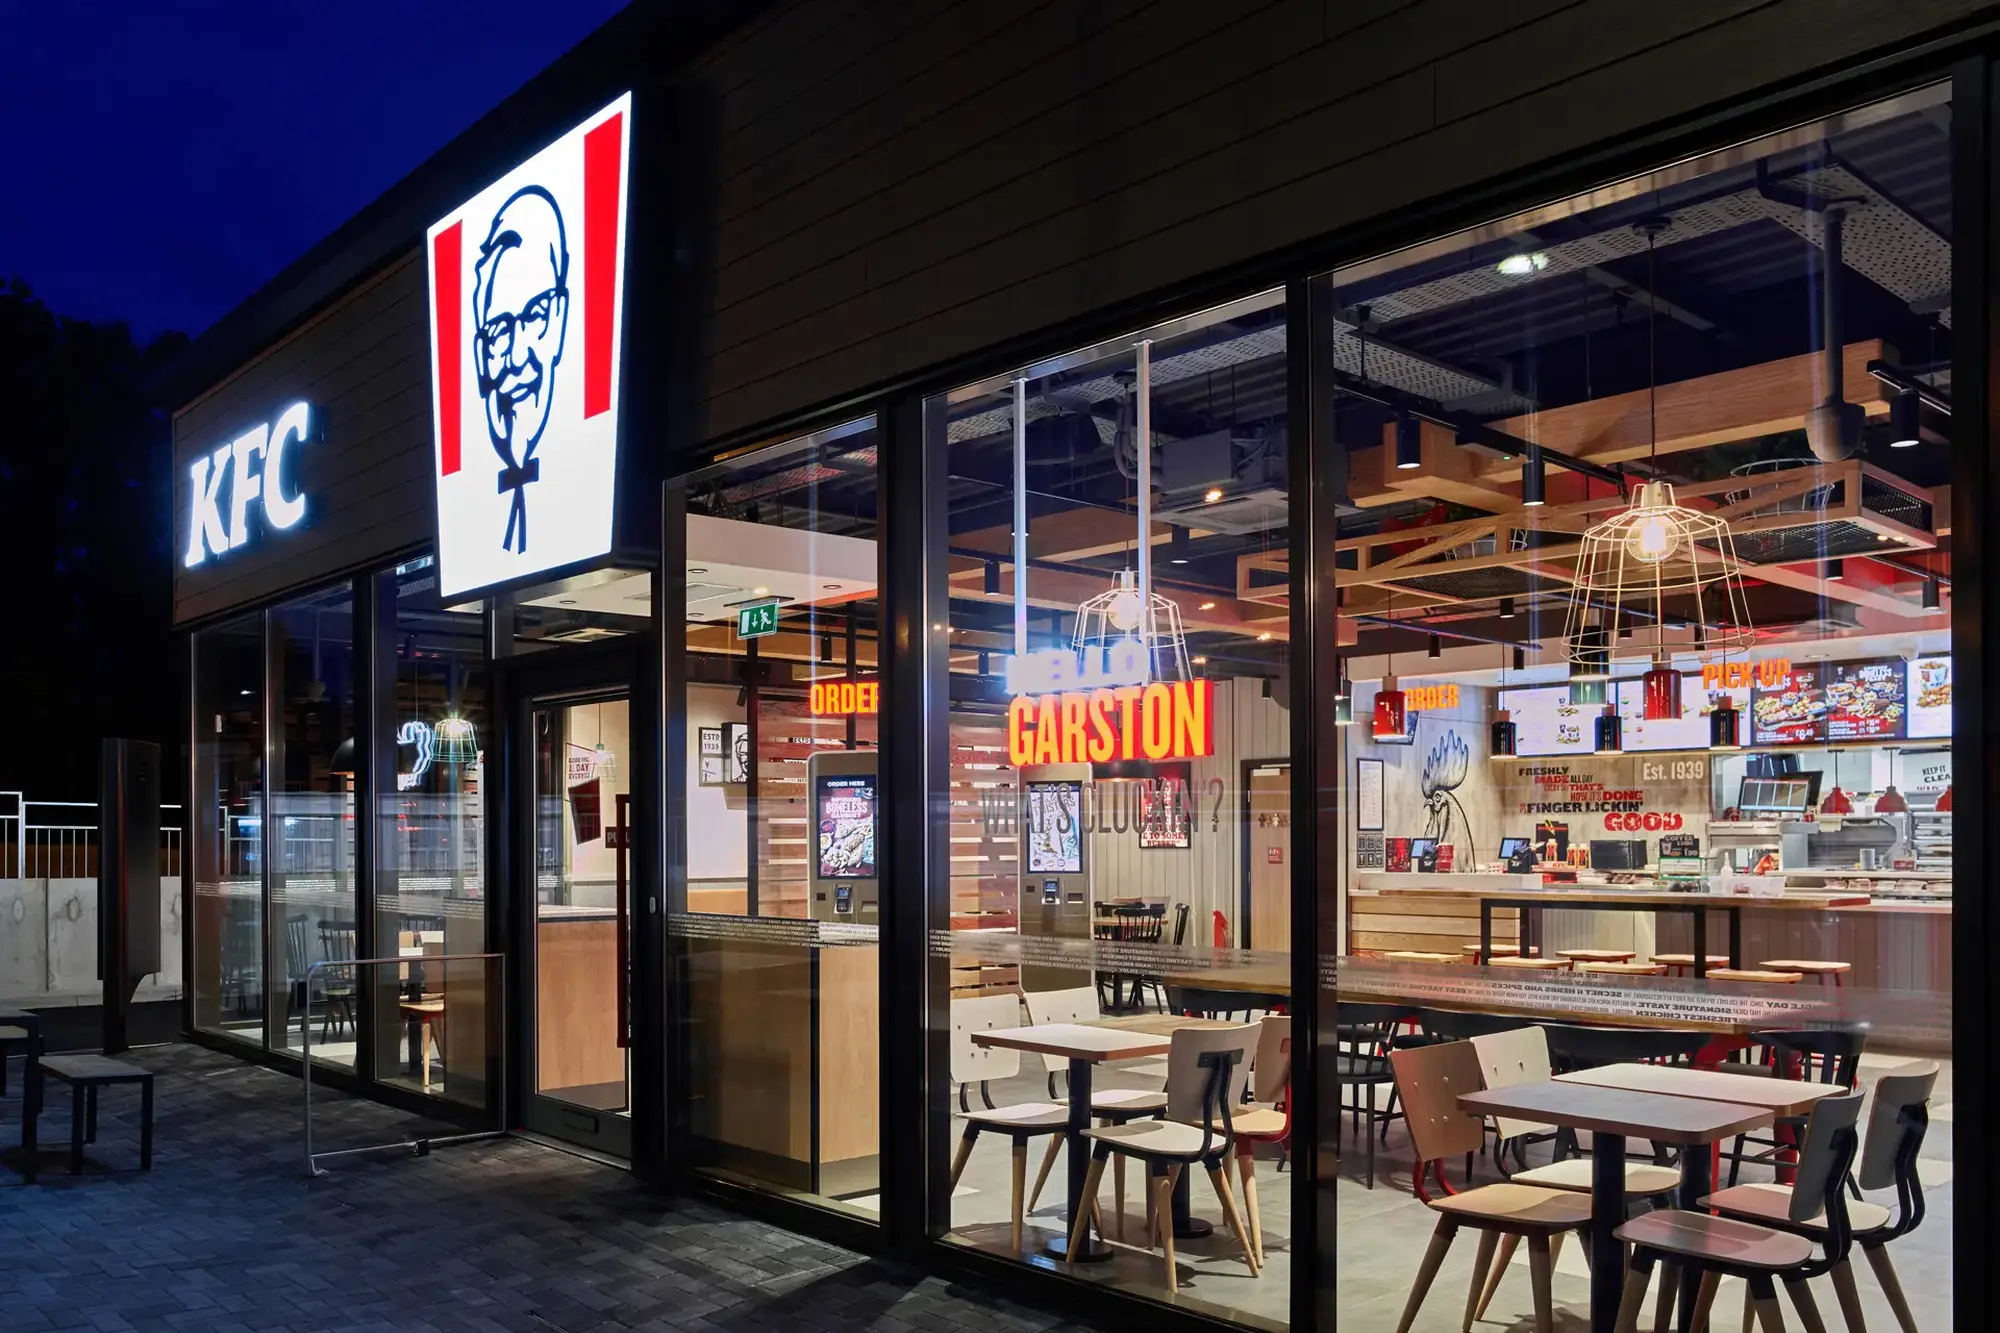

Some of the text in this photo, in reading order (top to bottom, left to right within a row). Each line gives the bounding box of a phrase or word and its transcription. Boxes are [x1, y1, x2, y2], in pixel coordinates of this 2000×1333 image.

[184, 401, 309, 568] KFC
[1703, 661, 1754, 690] PICK
[1760, 658, 1790, 687] UP
[1405, 684, 1459, 712] ORDER
[1009, 680, 1213, 767] GARSTON
[704, 743, 719, 751] 1939
[1518, 766, 1569, 777] FRESHLY
[1643, 761, 1704, 781] Est. 1939
[1922, 765, 1946, 776] KEEP IT
[1571, 775, 1580, 784] ALL
[1581, 774, 1593, 784] DAY
[1570, 783, 1604, 792] THAT'S
[1570, 791, 1588, 802] HOW
[1602, 790, 1643, 801] DONE
[826, 802, 868, 814] BONELESS
[1527, 802, 1582, 813] FINGER
[1584, 801, 1643, 812] LICKIN'
[1604, 812, 1682, 831] GOOD
